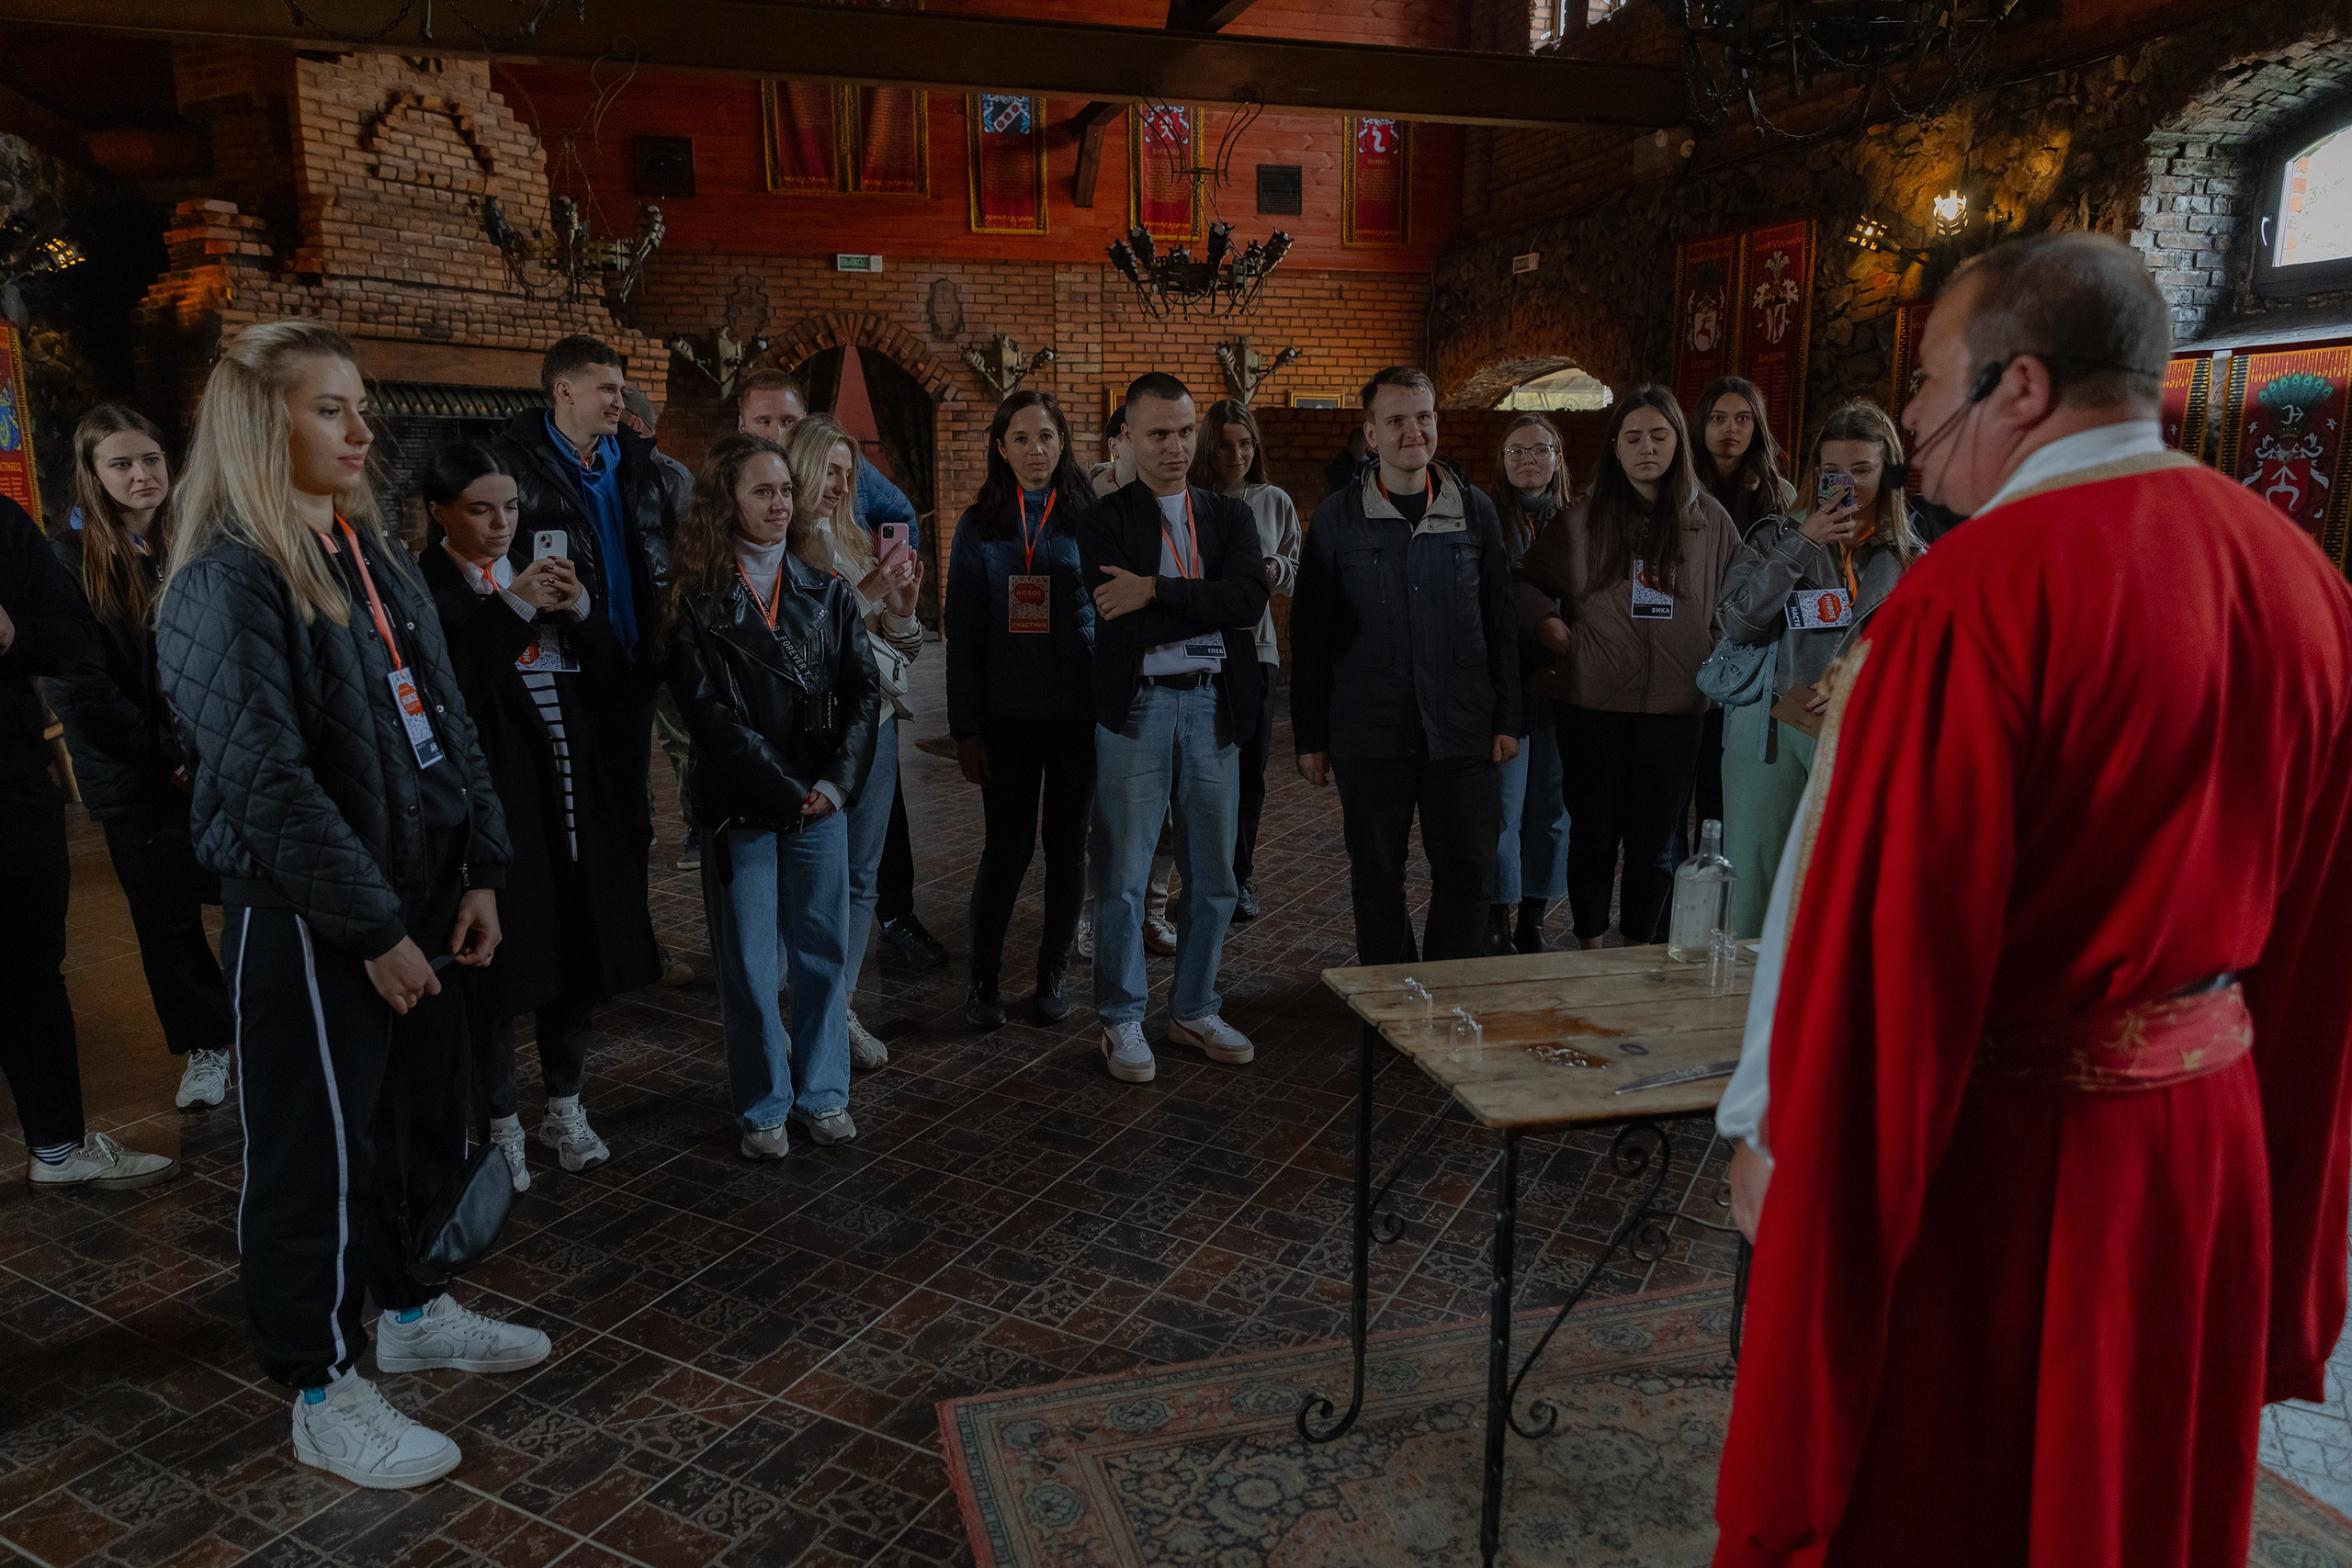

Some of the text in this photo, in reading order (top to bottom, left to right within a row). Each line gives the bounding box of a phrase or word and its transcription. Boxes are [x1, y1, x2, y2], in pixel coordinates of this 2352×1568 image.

[840, 258, 868, 267] ВЫХОД
[1791, 606, 1802, 627] НАСТЯ
[1824, 595, 1836, 619] НОВОЕ
[779, 636, 807, 670] FOREVER
